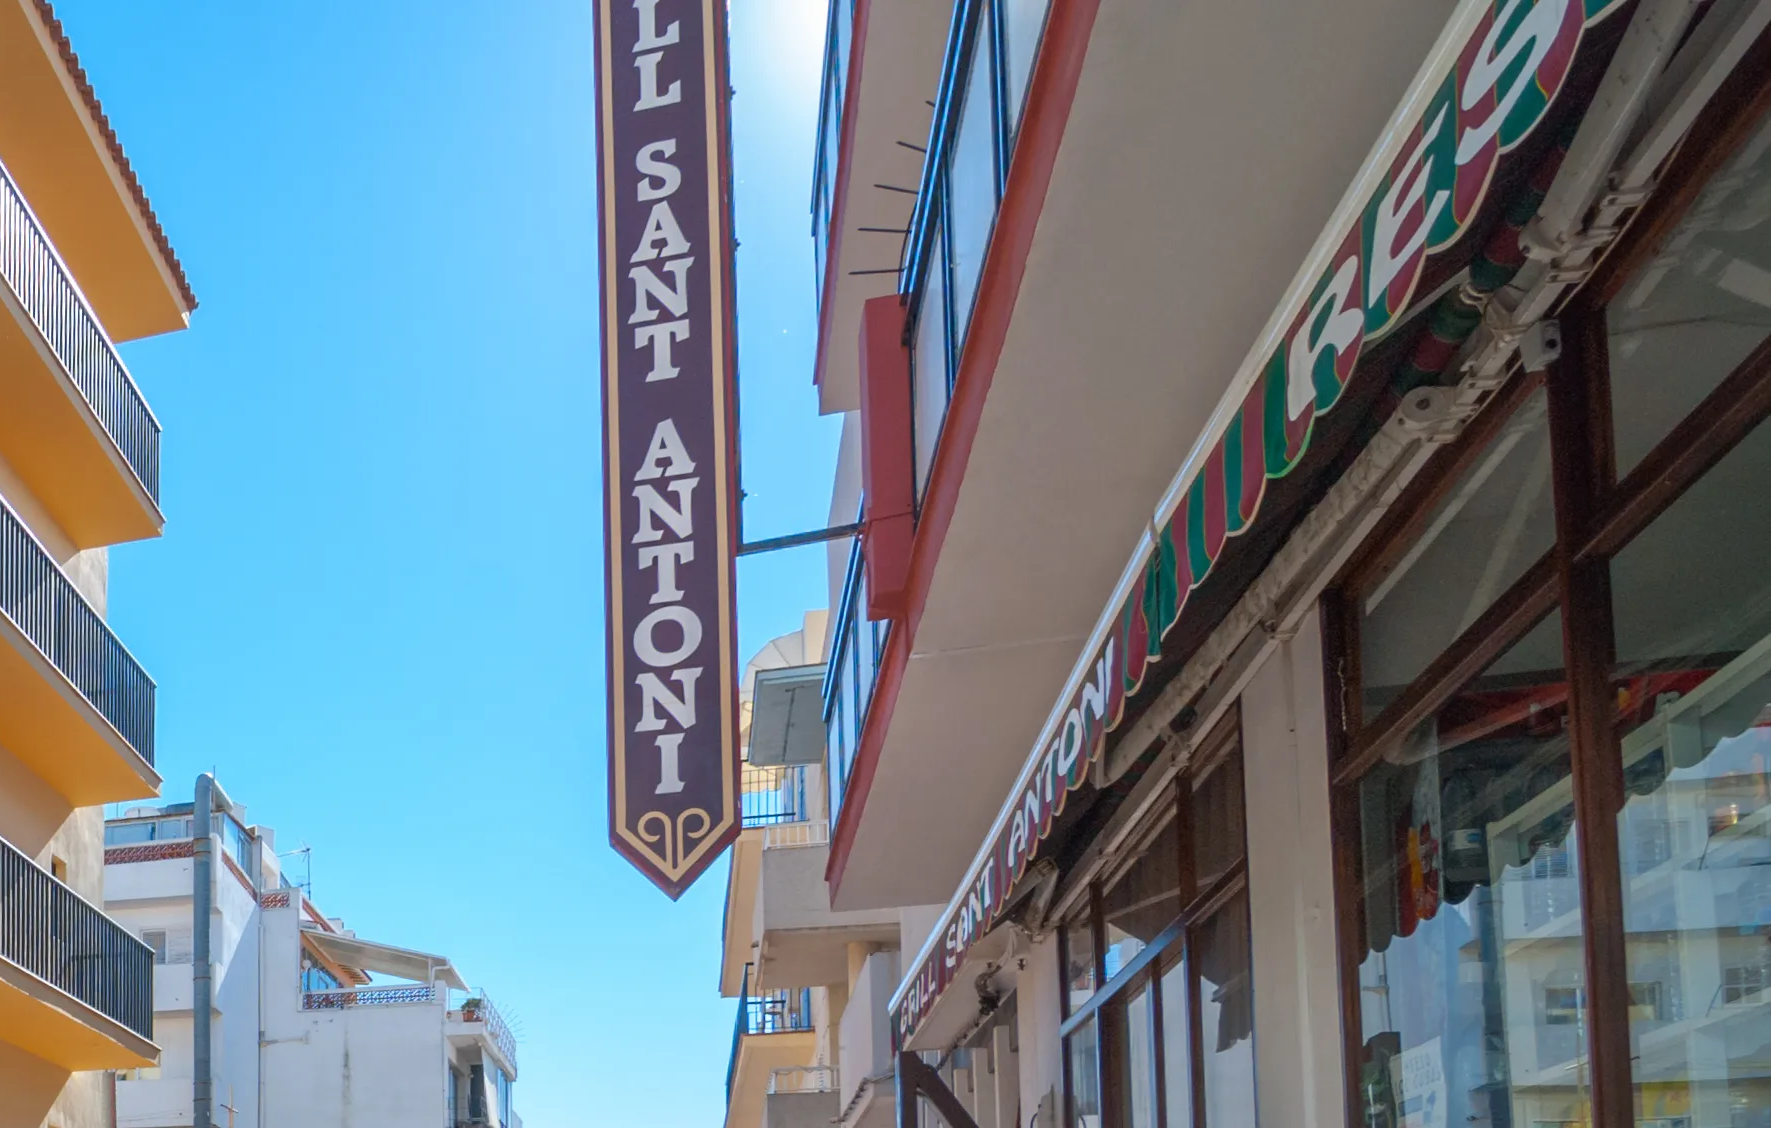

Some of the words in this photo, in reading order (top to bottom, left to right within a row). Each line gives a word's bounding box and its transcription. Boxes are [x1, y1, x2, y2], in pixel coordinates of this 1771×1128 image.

[628, 138, 694, 383] SANT
[632, 418, 703, 795] ANTONI
[900, 961, 935, 1034] GRILL
[945, 856, 993, 968] SANT
[1007, 636, 1114, 868] ANTONI
